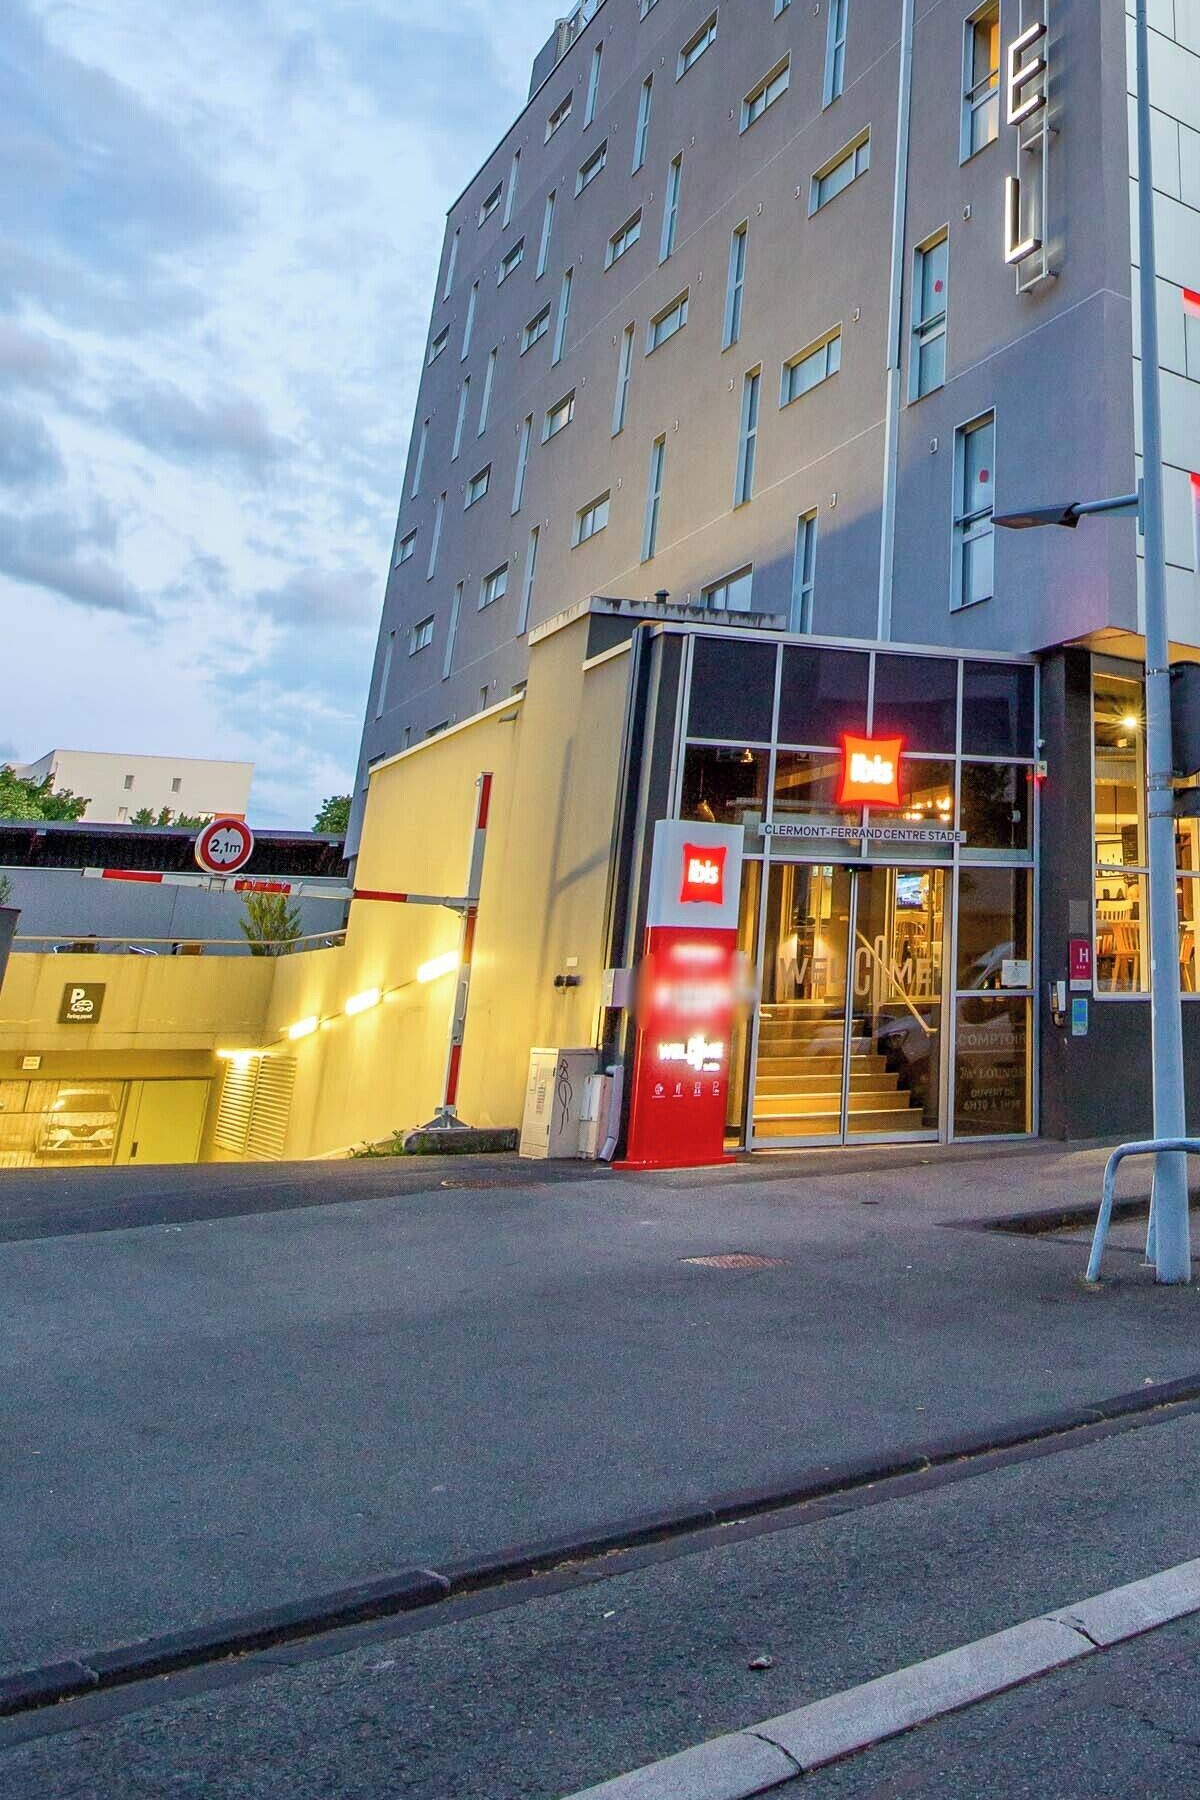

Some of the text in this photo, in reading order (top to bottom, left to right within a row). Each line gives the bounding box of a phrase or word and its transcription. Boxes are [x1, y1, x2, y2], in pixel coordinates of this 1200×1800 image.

[850, 752, 894, 785] ibis
[764, 823, 961, 842] CLERMONT-FERRAND CENTRE STADE
[209, 838, 241, 855] 2,1m
[687, 858, 719, 885] ibis
[1079, 947, 1089, 963] H
[70, 988, 86, 1004] P
